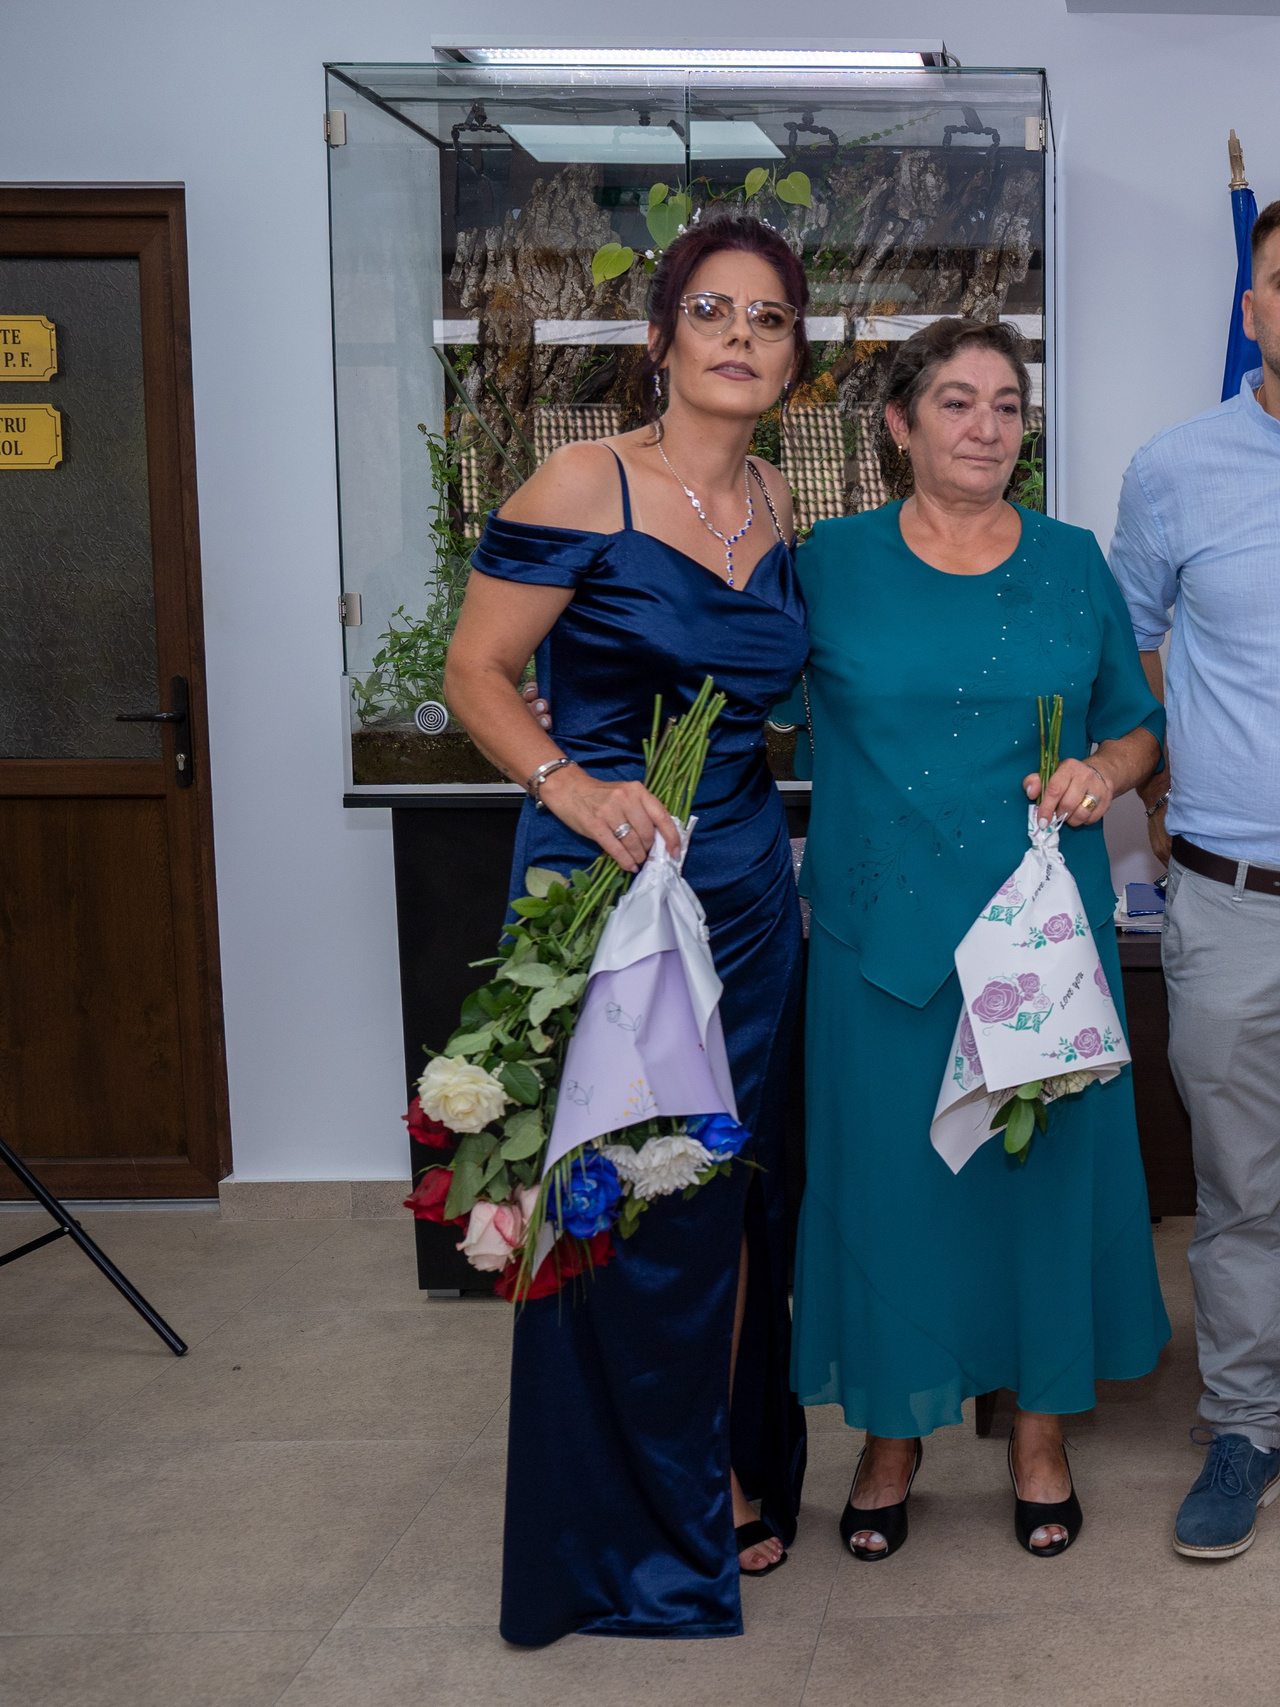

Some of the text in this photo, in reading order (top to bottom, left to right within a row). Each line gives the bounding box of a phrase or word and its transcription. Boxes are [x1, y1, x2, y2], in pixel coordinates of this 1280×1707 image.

[4, 351, 32, 368] P. F.
[0, 440, 23, 456] OL
